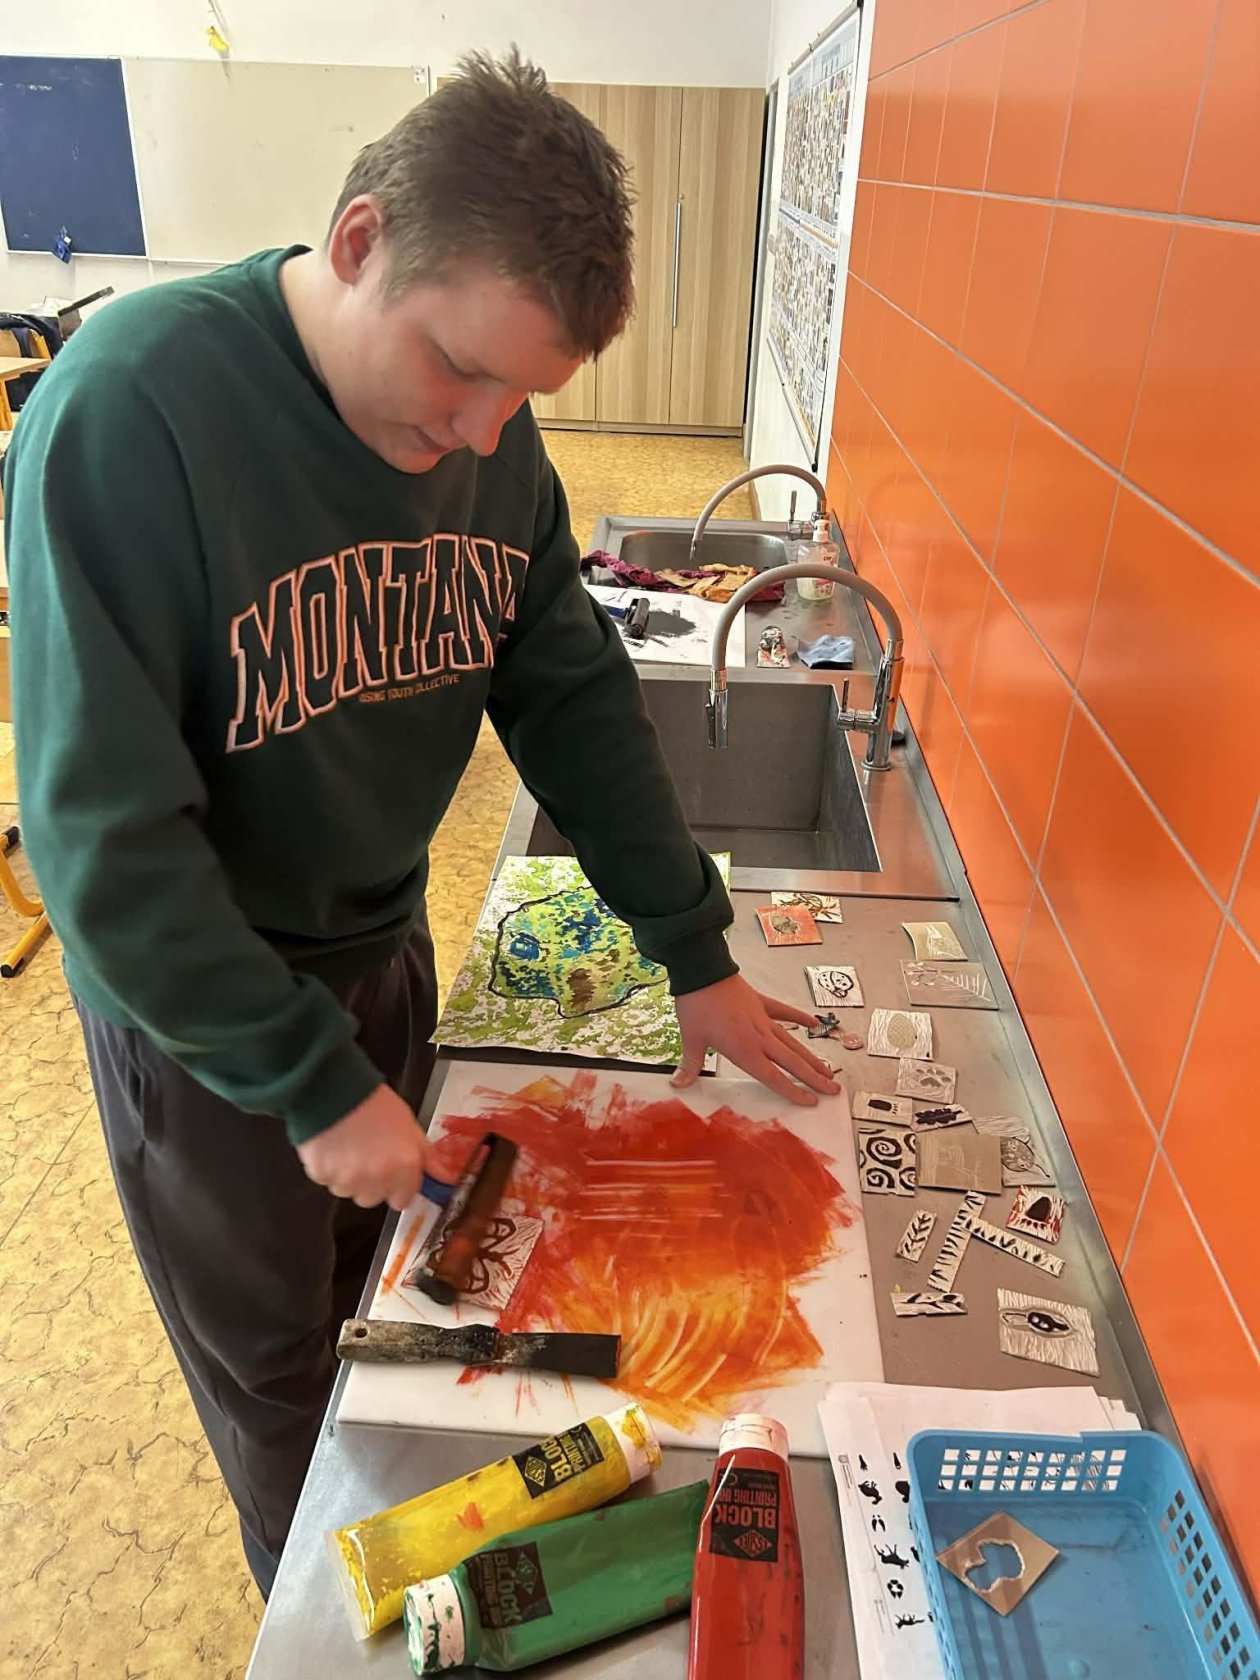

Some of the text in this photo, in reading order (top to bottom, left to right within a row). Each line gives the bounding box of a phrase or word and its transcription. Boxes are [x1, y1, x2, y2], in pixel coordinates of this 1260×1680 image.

[388, 687, 415, 701] YOUTH
[540, 1435, 574, 1482] BLOC
[734, 1488, 777, 1506] PRINTING
[714, 1503, 777, 1529] BLOCK
[493, 1551, 522, 1625] BLOCK
